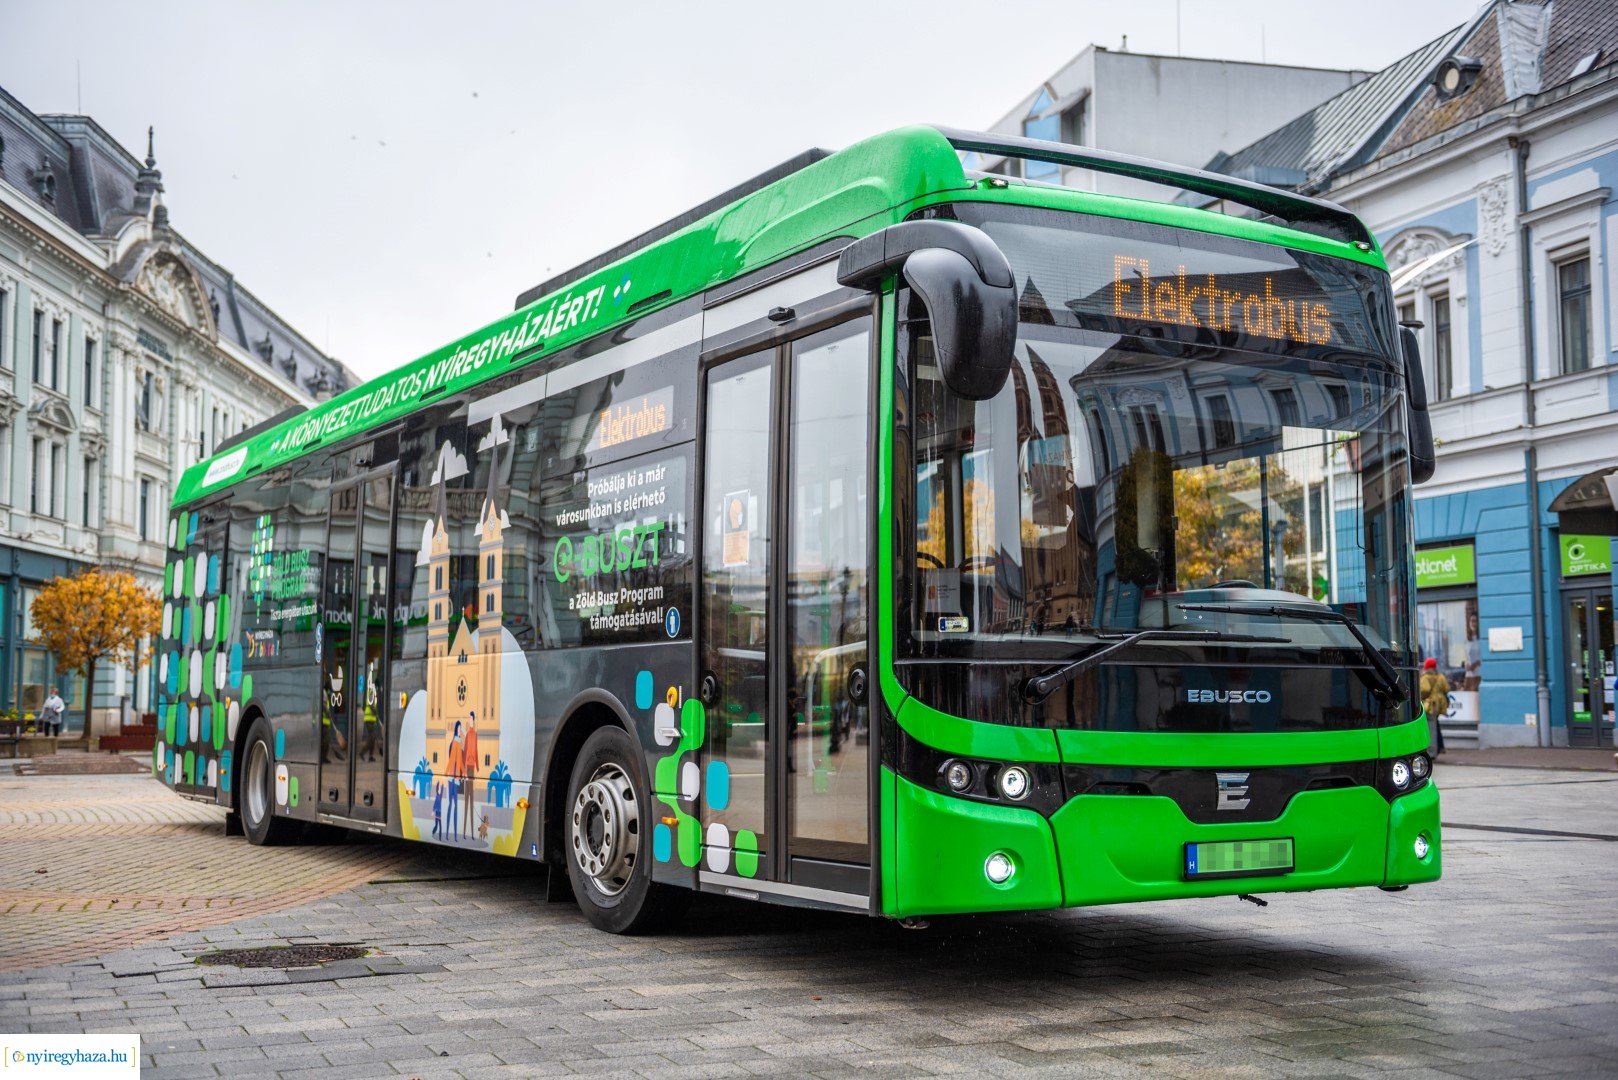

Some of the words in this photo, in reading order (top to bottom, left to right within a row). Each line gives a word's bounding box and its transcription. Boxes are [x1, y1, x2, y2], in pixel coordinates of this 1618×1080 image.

[1114, 255, 1332, 345] Elektrobus
[278, 432, 291, 453] A
[289, 368, 427, 447] KÖRNYEZETTUDATOS
[423, 285, 606, 392] NYÍREGYHÁZÁÉRT!
[600, 398, 666, 448] Elektrobus
[588, 473, 625, 498] Próbálja
[627, 470, 636, 488] ki
[638, 474, 644, 486] a
[645, 464, 666, 483] már
[556, 500, 612, 527] városunkban
[614, 498, 622, 514] is
[623, 486, 666, 511] elérhető
[291, 549, 310, 572] BUSZ
[1569, 562, 1607, 573] OPTIKA
[569, 597, 575, 610] a
[576, 592, 595, 609] Zöld
[597, 590, 619, 606] Busz
[620, 586, 664, 606] Program
[589, 607, 664, 631] támogatásával!
[1187, 689, 1272, 704] EBUSCO
[1189, 861, 1195, 870] H
